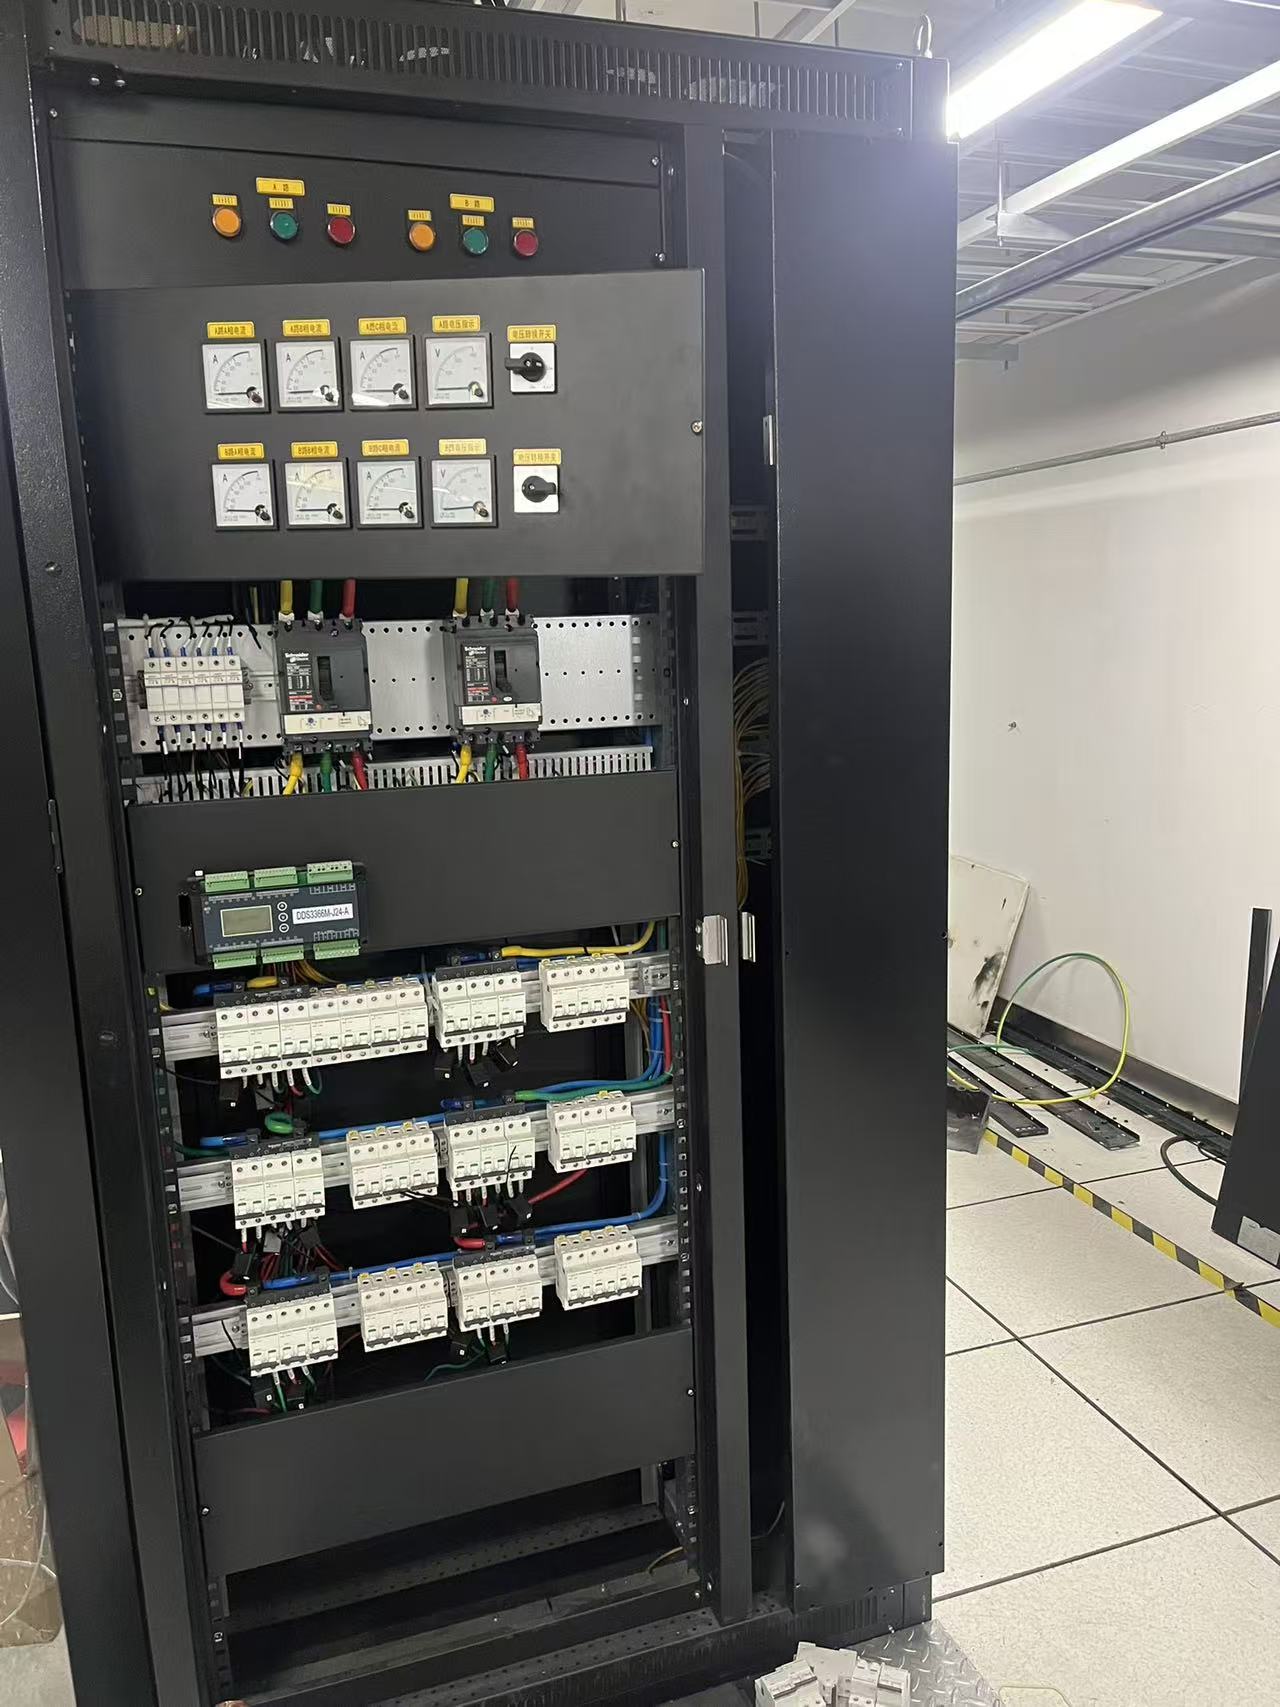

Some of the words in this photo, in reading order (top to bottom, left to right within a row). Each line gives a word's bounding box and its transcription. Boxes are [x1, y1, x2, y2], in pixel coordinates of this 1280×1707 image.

[285, 353, 292, 362] A
[359, 351, 366, 361] A
[434, 348, 441, 358] V
[212, 354, 219, 364] A
[222, 473, 229, 482] A
[366, 471, 373, 480] A
[440, 468, 447, 478] V
[296, 907, 350, 920] DDS3366M-J24-A
